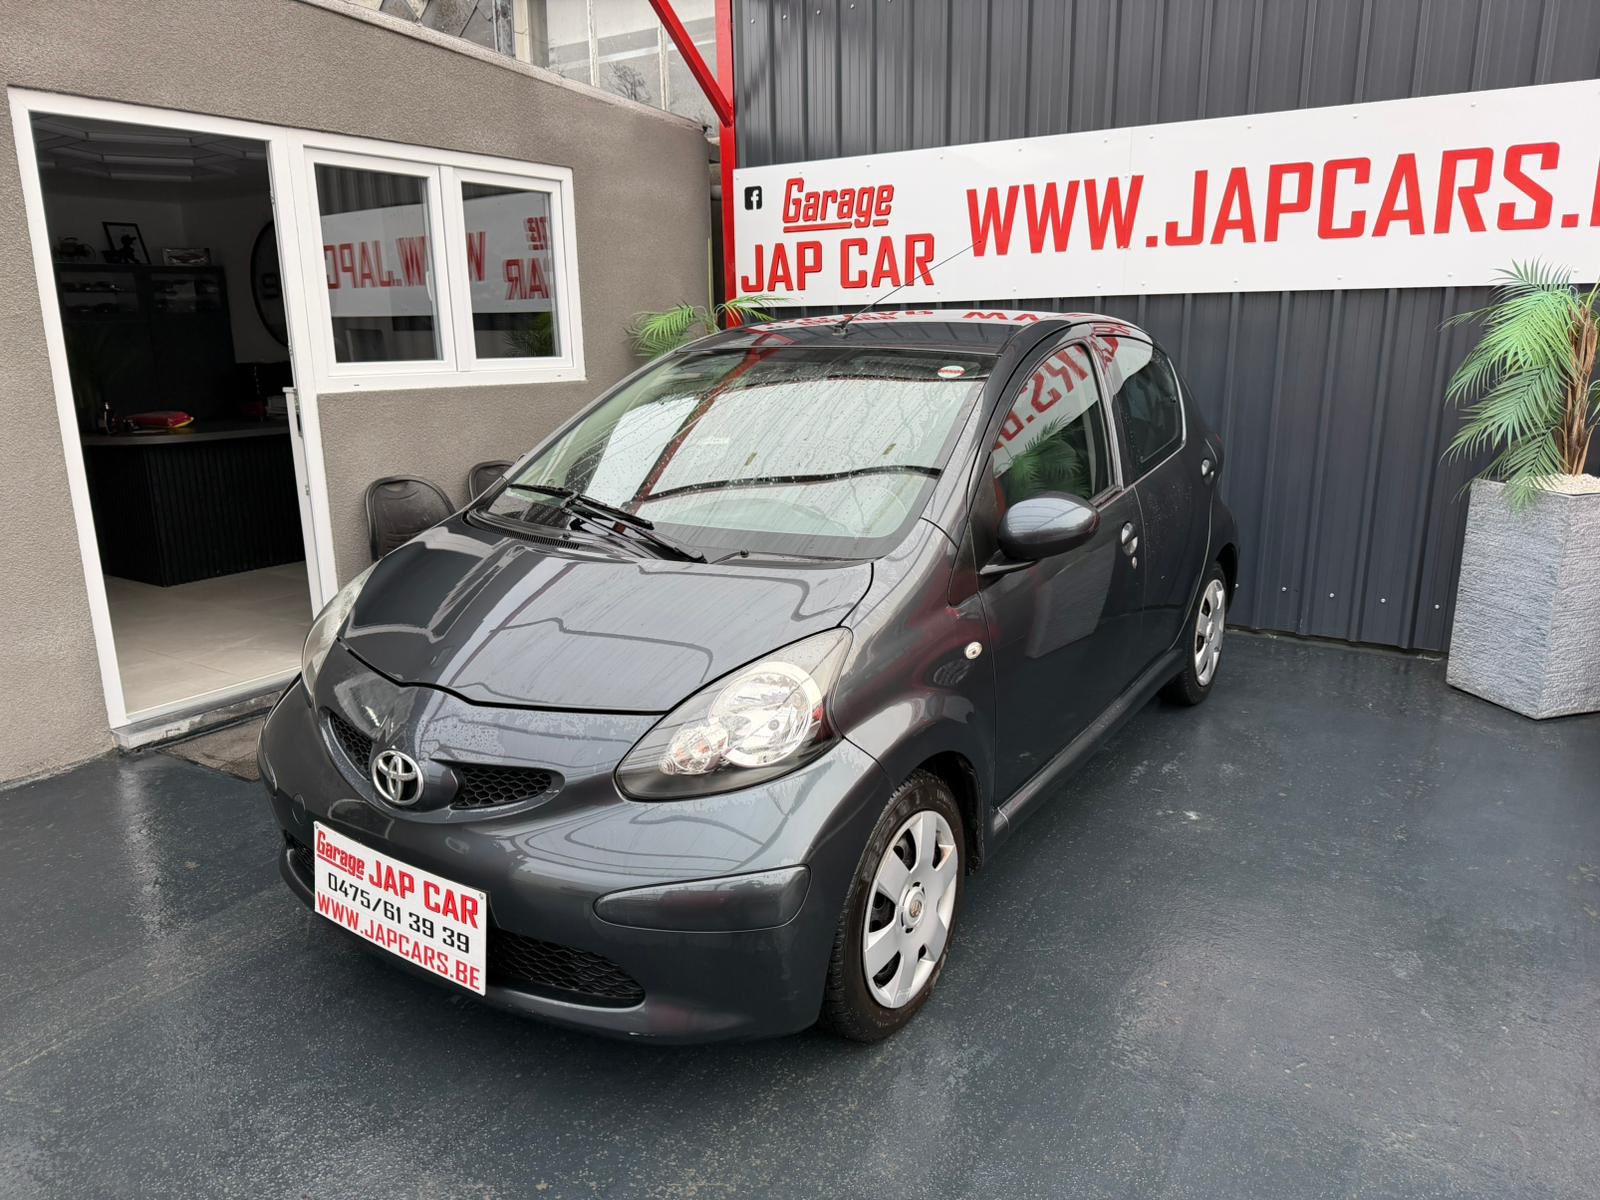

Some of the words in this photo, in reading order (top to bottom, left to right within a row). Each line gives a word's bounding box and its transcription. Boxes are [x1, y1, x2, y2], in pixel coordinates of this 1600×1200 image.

[782, 177, 895, 230] Garage
[966, 142, 1600, 257] WWW.JAPCARS.
[741, 240, 823, 293] JAP
[840, 233, 935, 290] CAR
[316, 829, 365, 877] Garage
[369, 860, 415, 899] JAP
[423, 880, 479, 929] CAR
[327, 872, 402, 924] 0475/61
[408, 912, 434, 939] 39
[442, 926, 470, 954] 39
[317, 891, 481, 991] WWW.JAPCARS.BE
